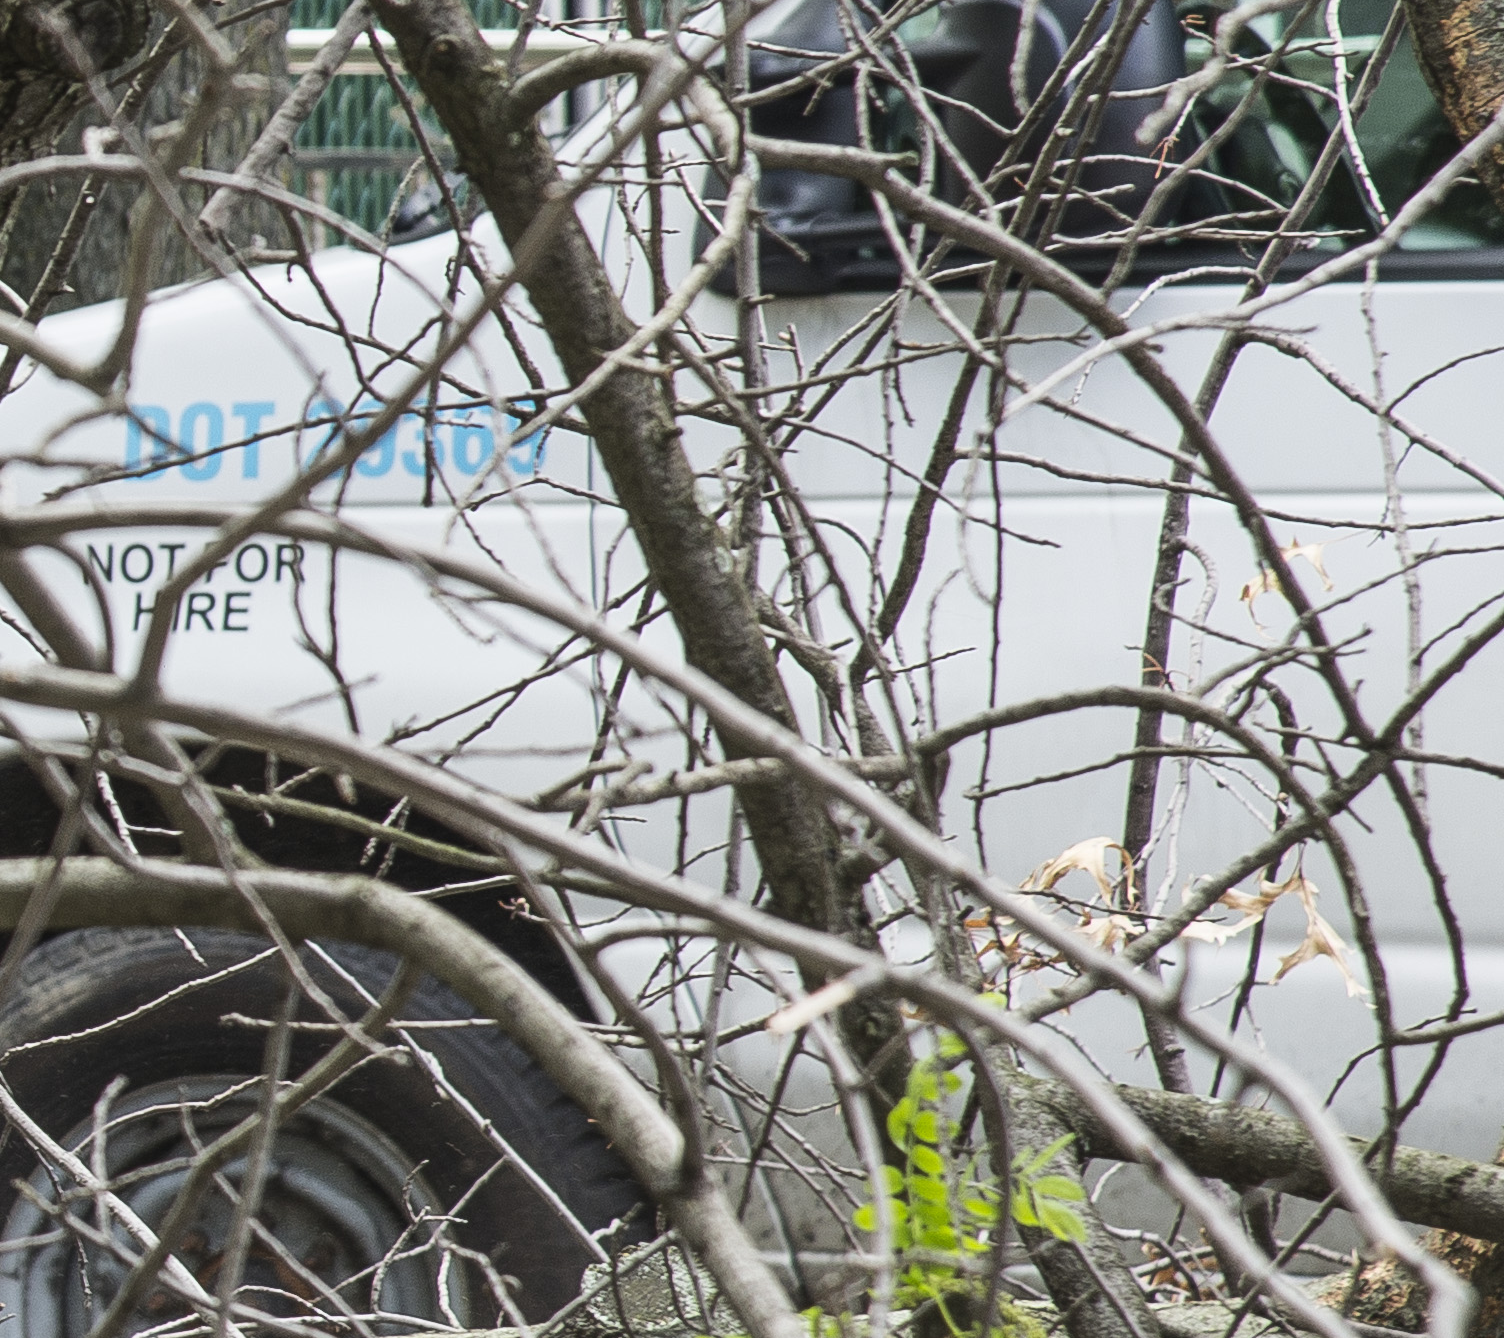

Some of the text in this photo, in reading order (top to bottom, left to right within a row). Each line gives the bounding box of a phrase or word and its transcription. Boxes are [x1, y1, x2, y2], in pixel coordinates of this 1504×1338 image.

[125, 401, 275, 482] DOT
[88, 543, 186, 583] NOT
[133, 592, 252, 632] HIRE
